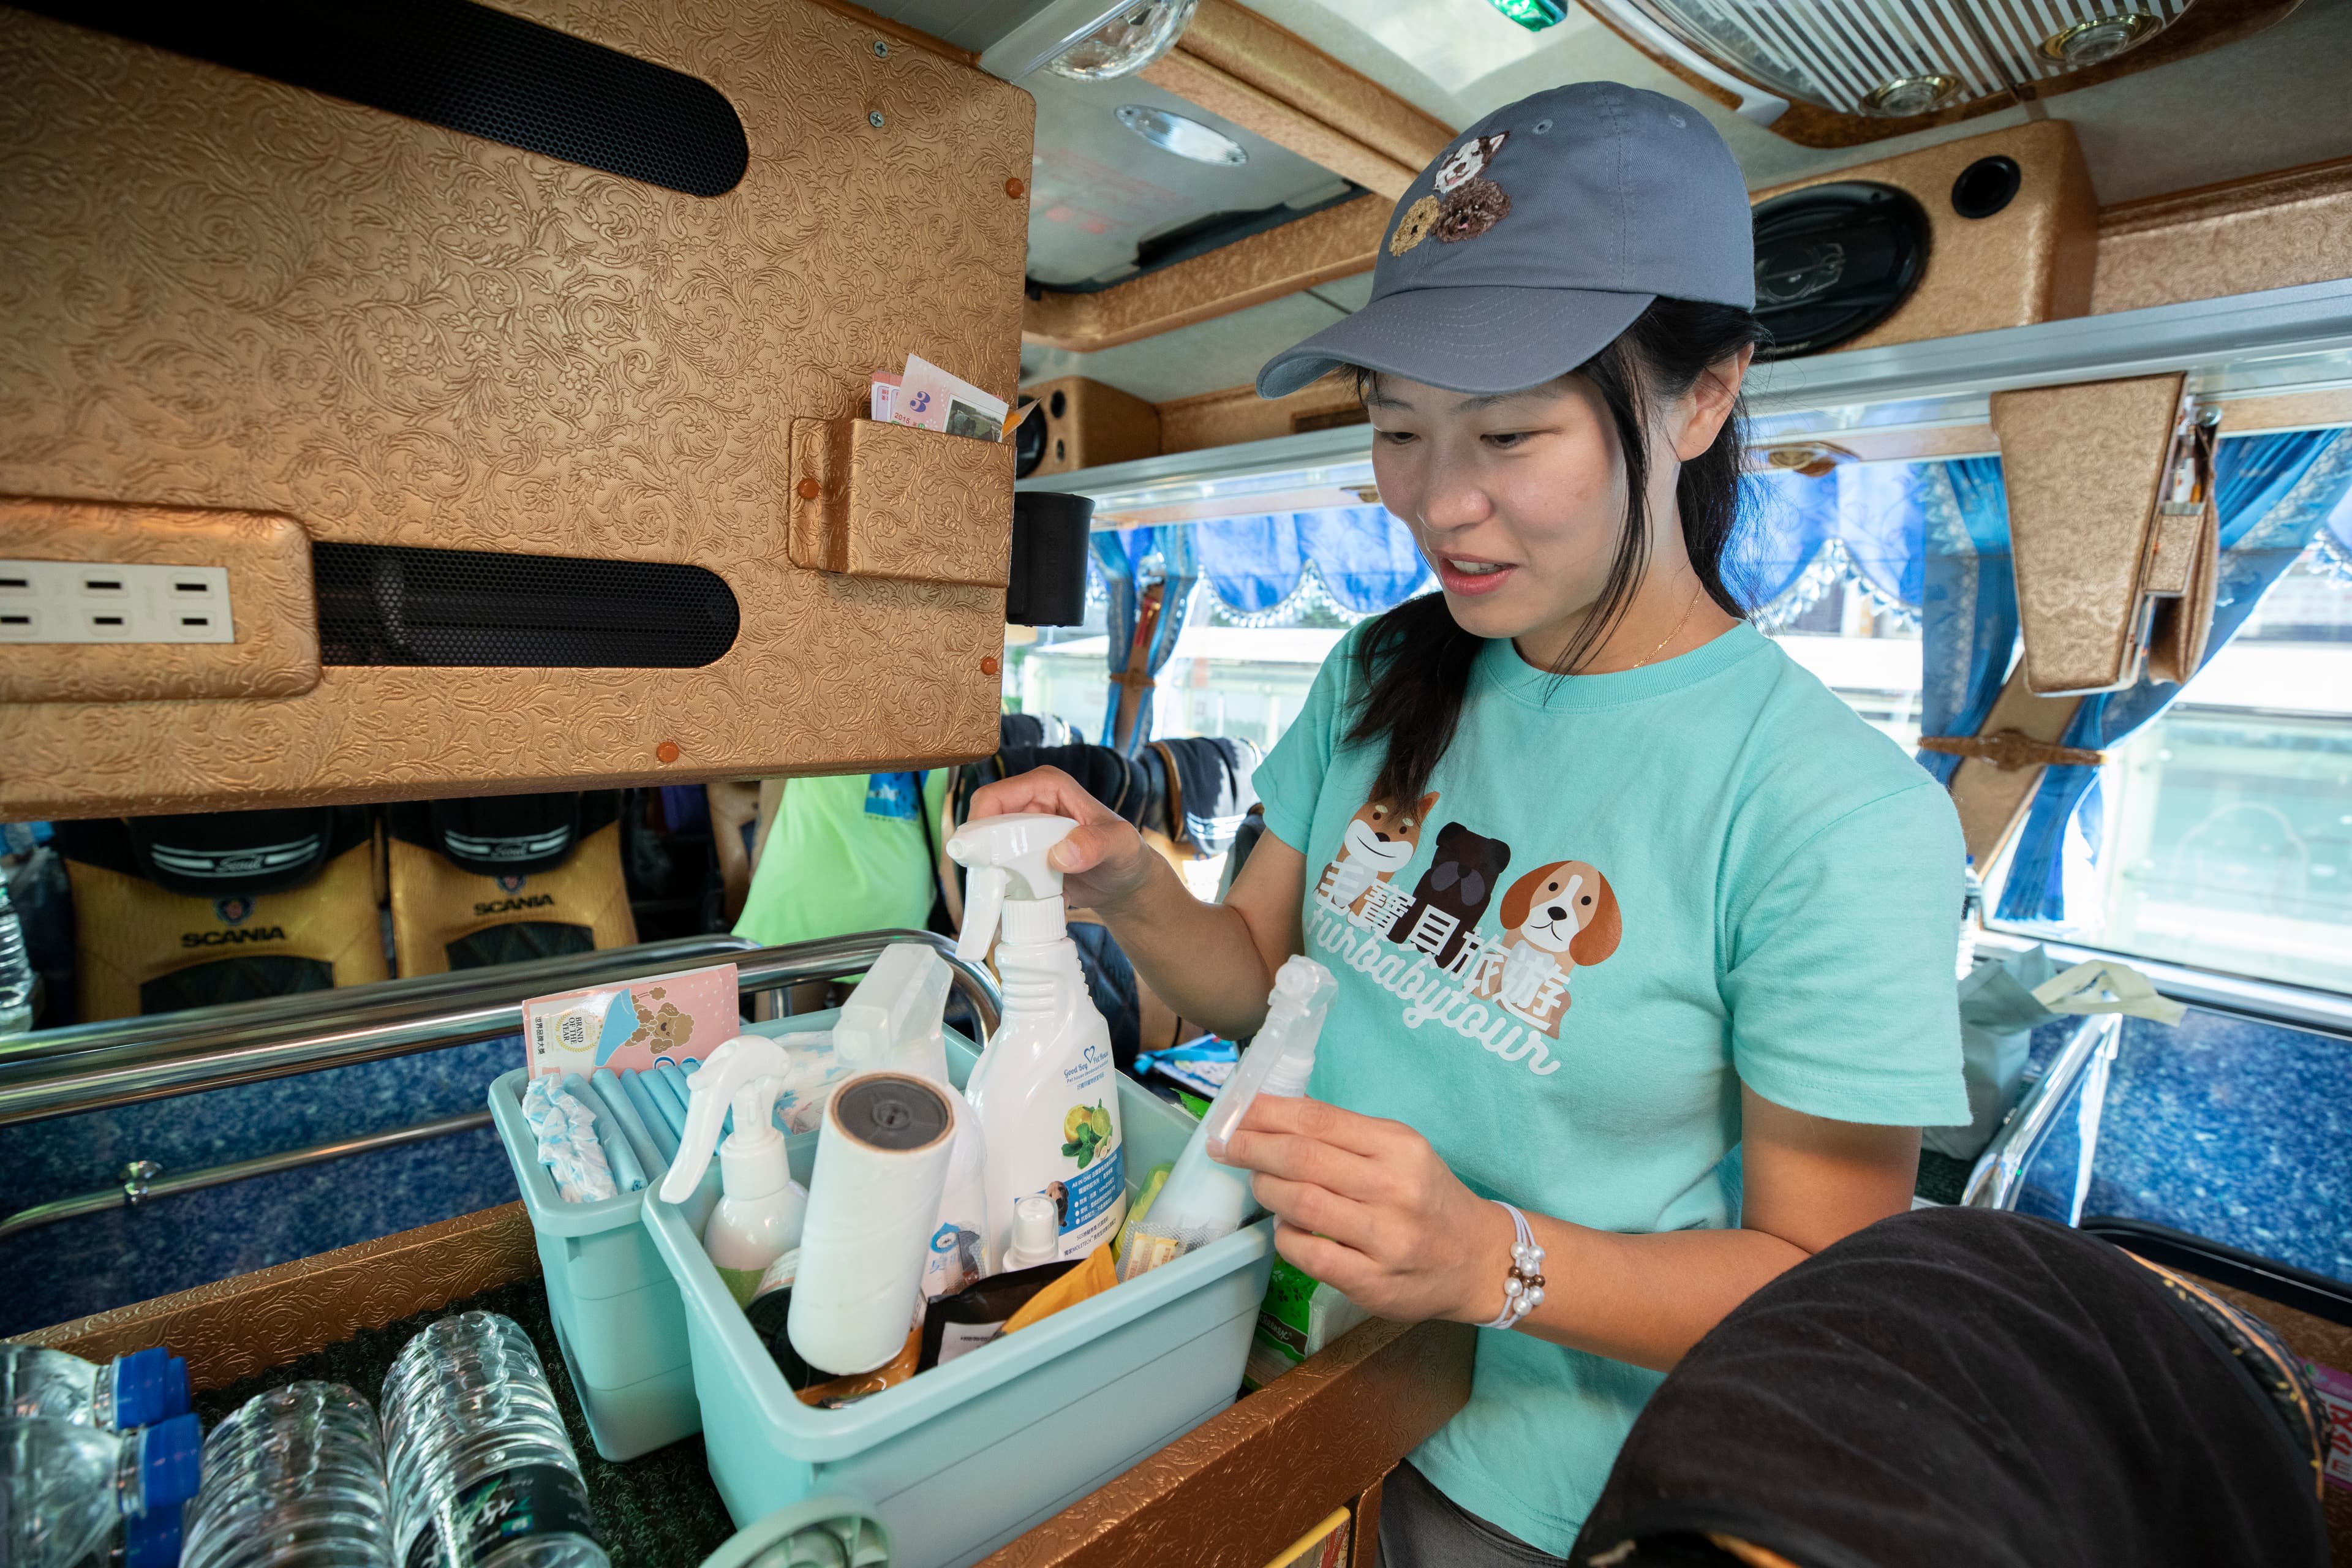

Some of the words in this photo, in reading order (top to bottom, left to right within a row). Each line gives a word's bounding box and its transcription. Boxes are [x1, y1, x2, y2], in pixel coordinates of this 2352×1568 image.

[910, 391, 930, 412] 3
[894, 412, 911, 424] 2015
[473, 893, 555, 916] SCANIA
[181, 925, 286, 948] SCANIA
[1313, 859, 1571, 1031] 毛寶貝旅遊
[568, 1017, 576, 1027] OF
[1064, 1066, 1078, 1079] Good
[1078, 1063, 1088, 1071] Boy
[1083, 1174, 1092, 1183] ONE
